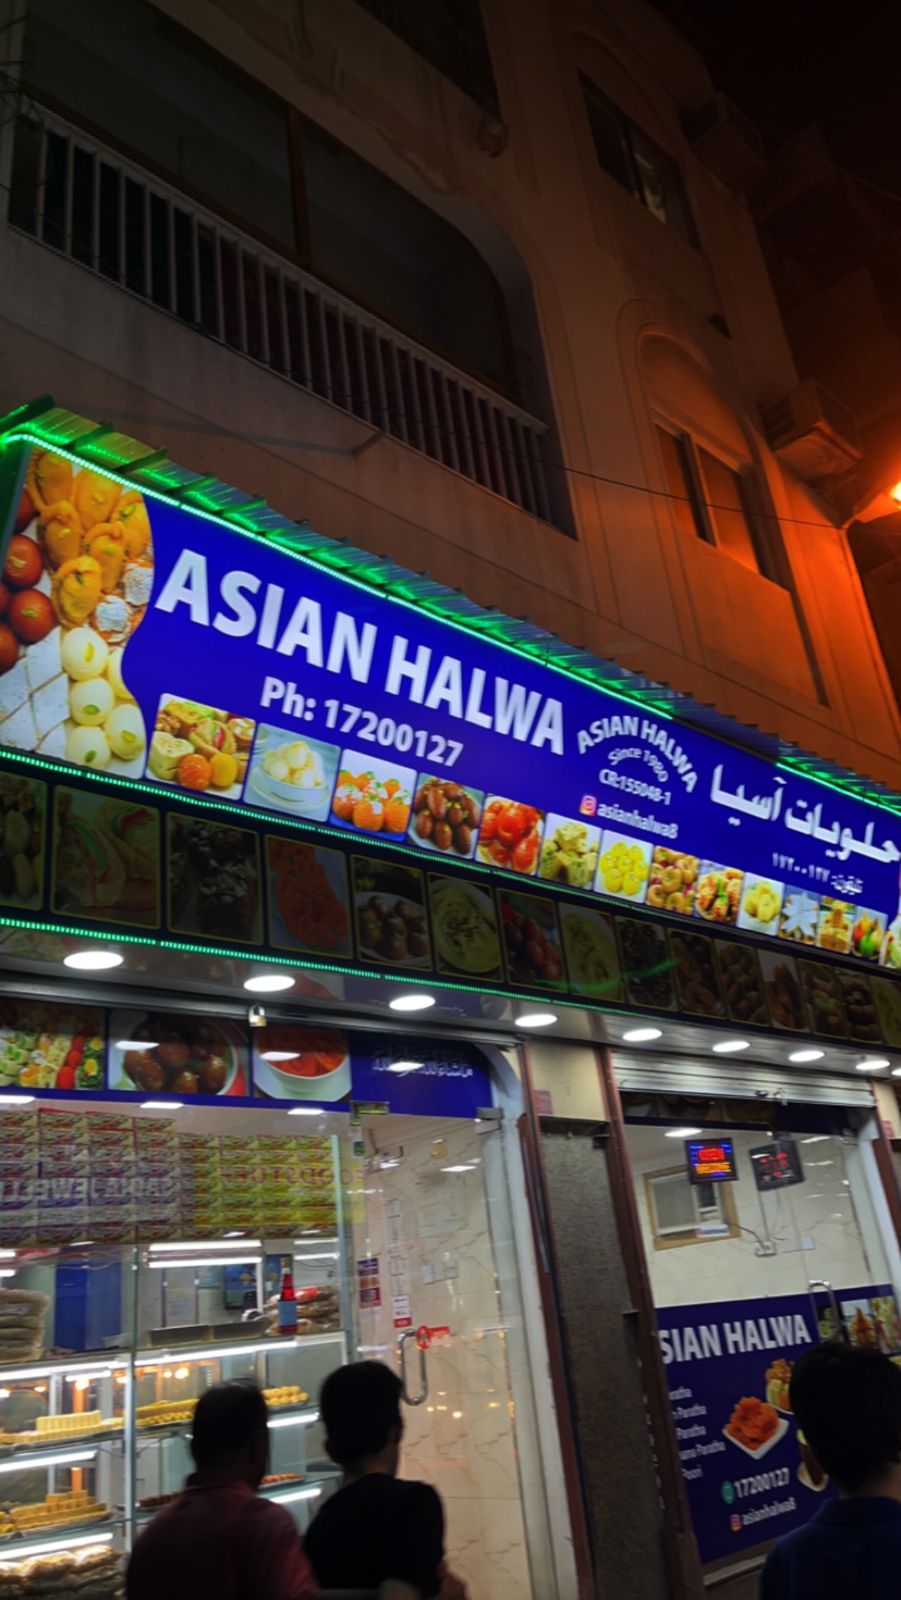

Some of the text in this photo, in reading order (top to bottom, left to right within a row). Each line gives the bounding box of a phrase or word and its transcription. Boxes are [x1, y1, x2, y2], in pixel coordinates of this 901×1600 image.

[155, 548, 565, 756] ASIAN HALWA
[260, 676, 465, 768] Ph: 17200127
[577, 715, 698, 793] ASIAN HALWA
[608, 747, 669, 782] Since 1980
[597, 803, 679, 839] asianhalwa8
[710, 764, 901, 863] حلويات آسيا
[658, 1314, 812, 1365] SIAN HALWA
[734, 1467, 790, 1498] 17200127
[742, 1497, 797, 1525] asianhalwa8
